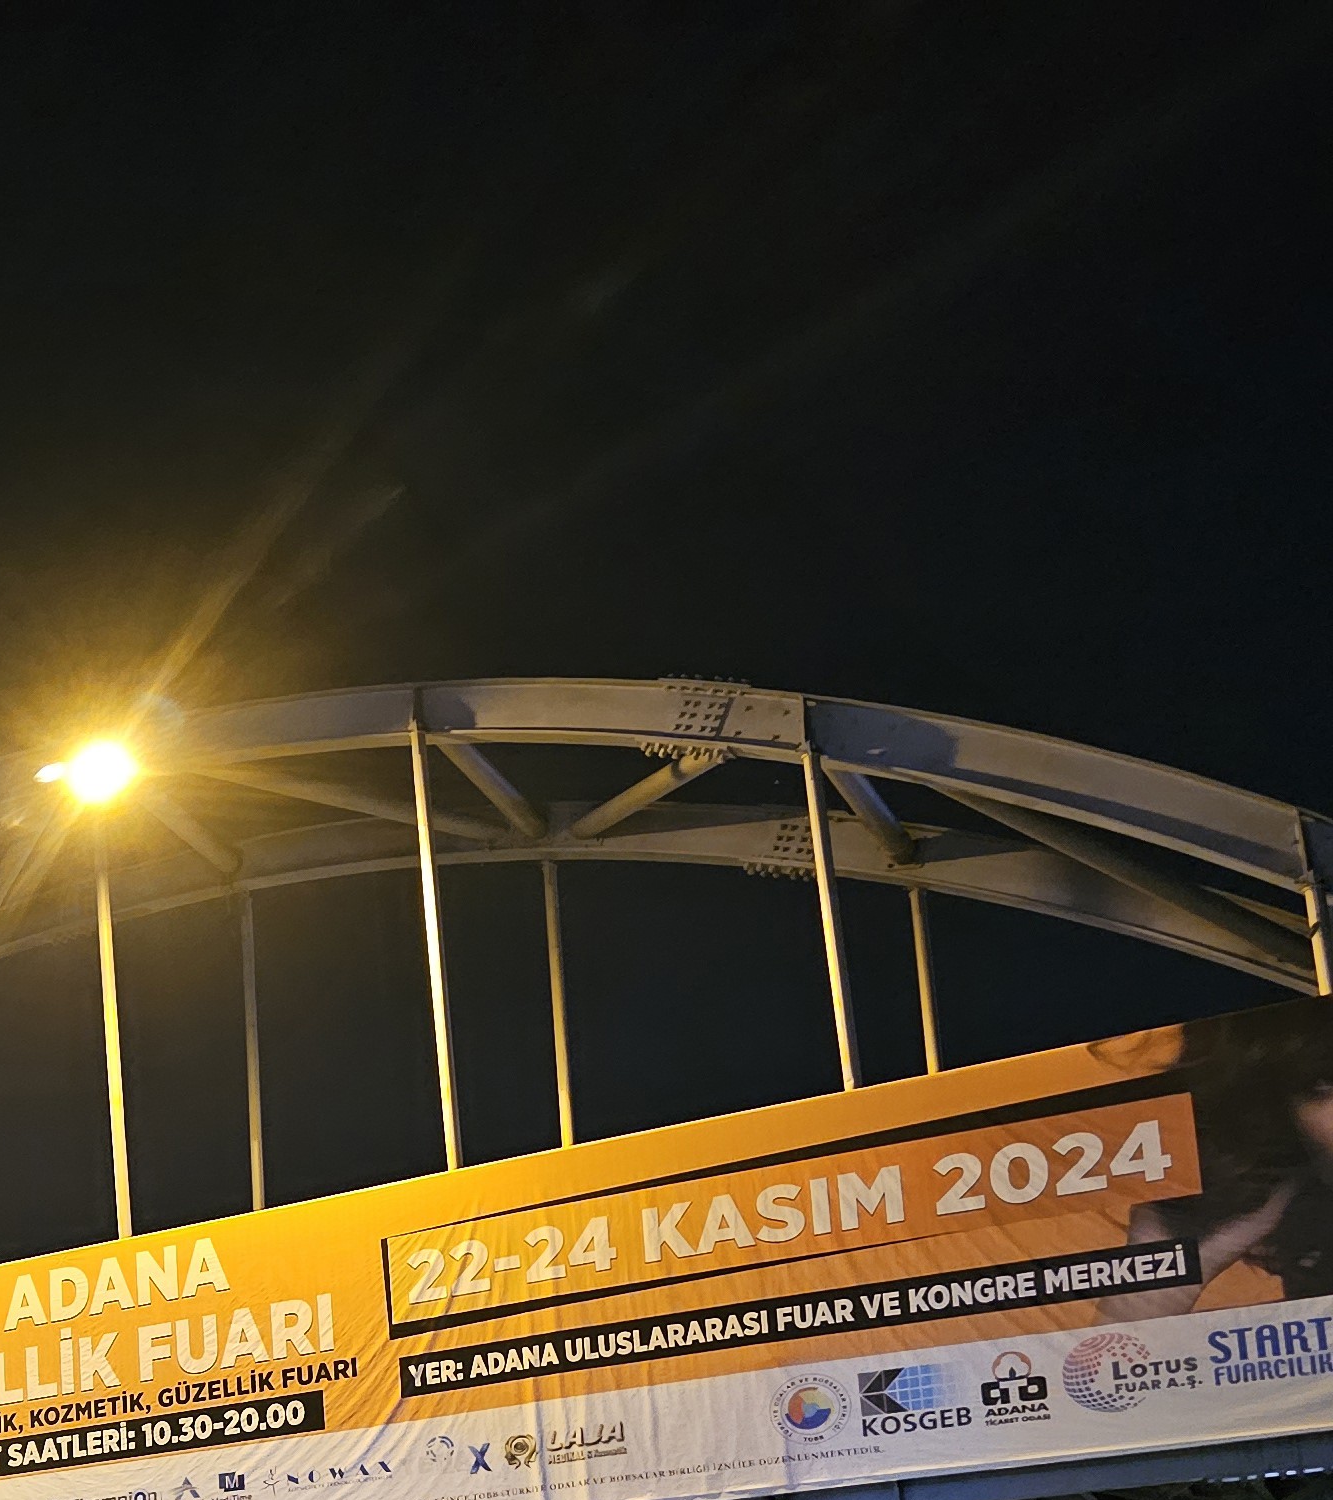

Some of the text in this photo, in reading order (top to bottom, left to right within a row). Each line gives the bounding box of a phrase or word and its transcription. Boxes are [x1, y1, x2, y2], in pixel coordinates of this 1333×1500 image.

[407, 1119, 1172, 1304] 22-24 KASIM 2024
[4, 1237, 230, 1333] ADANA
[408, 1244, 1186, 1387] YER: ADANA ULUSLARARASI FUAR VE KONGRE MERKEZİ
[138, 1294, 335, 1382] FUARI
[1112, 1356, 1198, 1380] LOTUS
[1208, 1317, 1332, 1363] START
[29, 1392, 151, 1428] KOZMETİK,
[158, 1371, 273, 1408] GÜZELLİK
[281, 1357, 358, 1390] FUARI
[985, 1403, 1049, 1417] ADANA
[1115, 1380, 1162, 1394] FUAR
[8, 1422, 136, 1466] SAATLERİ:
[141, 1400, 305, 1446] 10.30-20.00
[862, 1407, 972, 1437] KOSGEB
